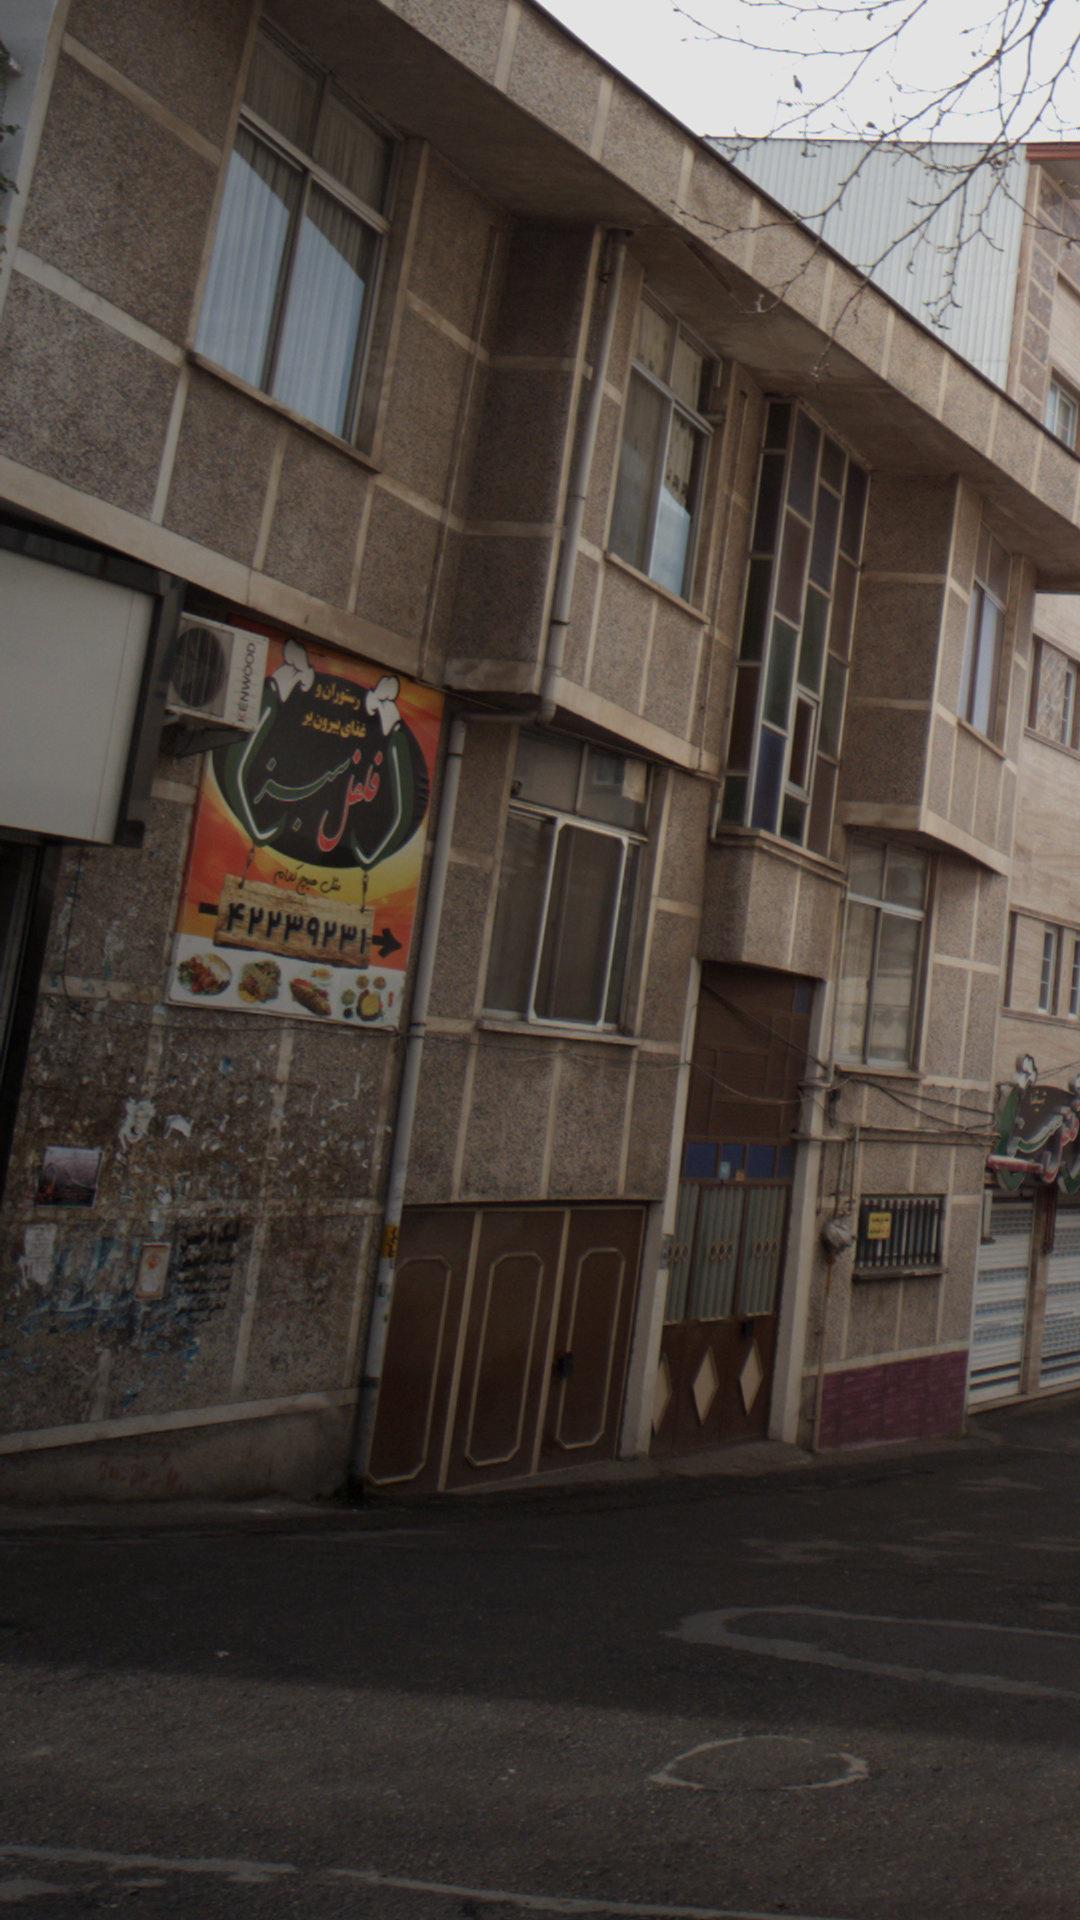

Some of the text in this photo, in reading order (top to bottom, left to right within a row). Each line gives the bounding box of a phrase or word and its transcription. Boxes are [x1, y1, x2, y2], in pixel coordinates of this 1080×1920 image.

[238, 642, 255, 722] KENWOOD
[322, 682, 361, 711] رستوران
[313, 714, 340, 734] بیرون
[340, 720, 367, 738] غذای
[253, 749, 383, 852] فلفل سبز
